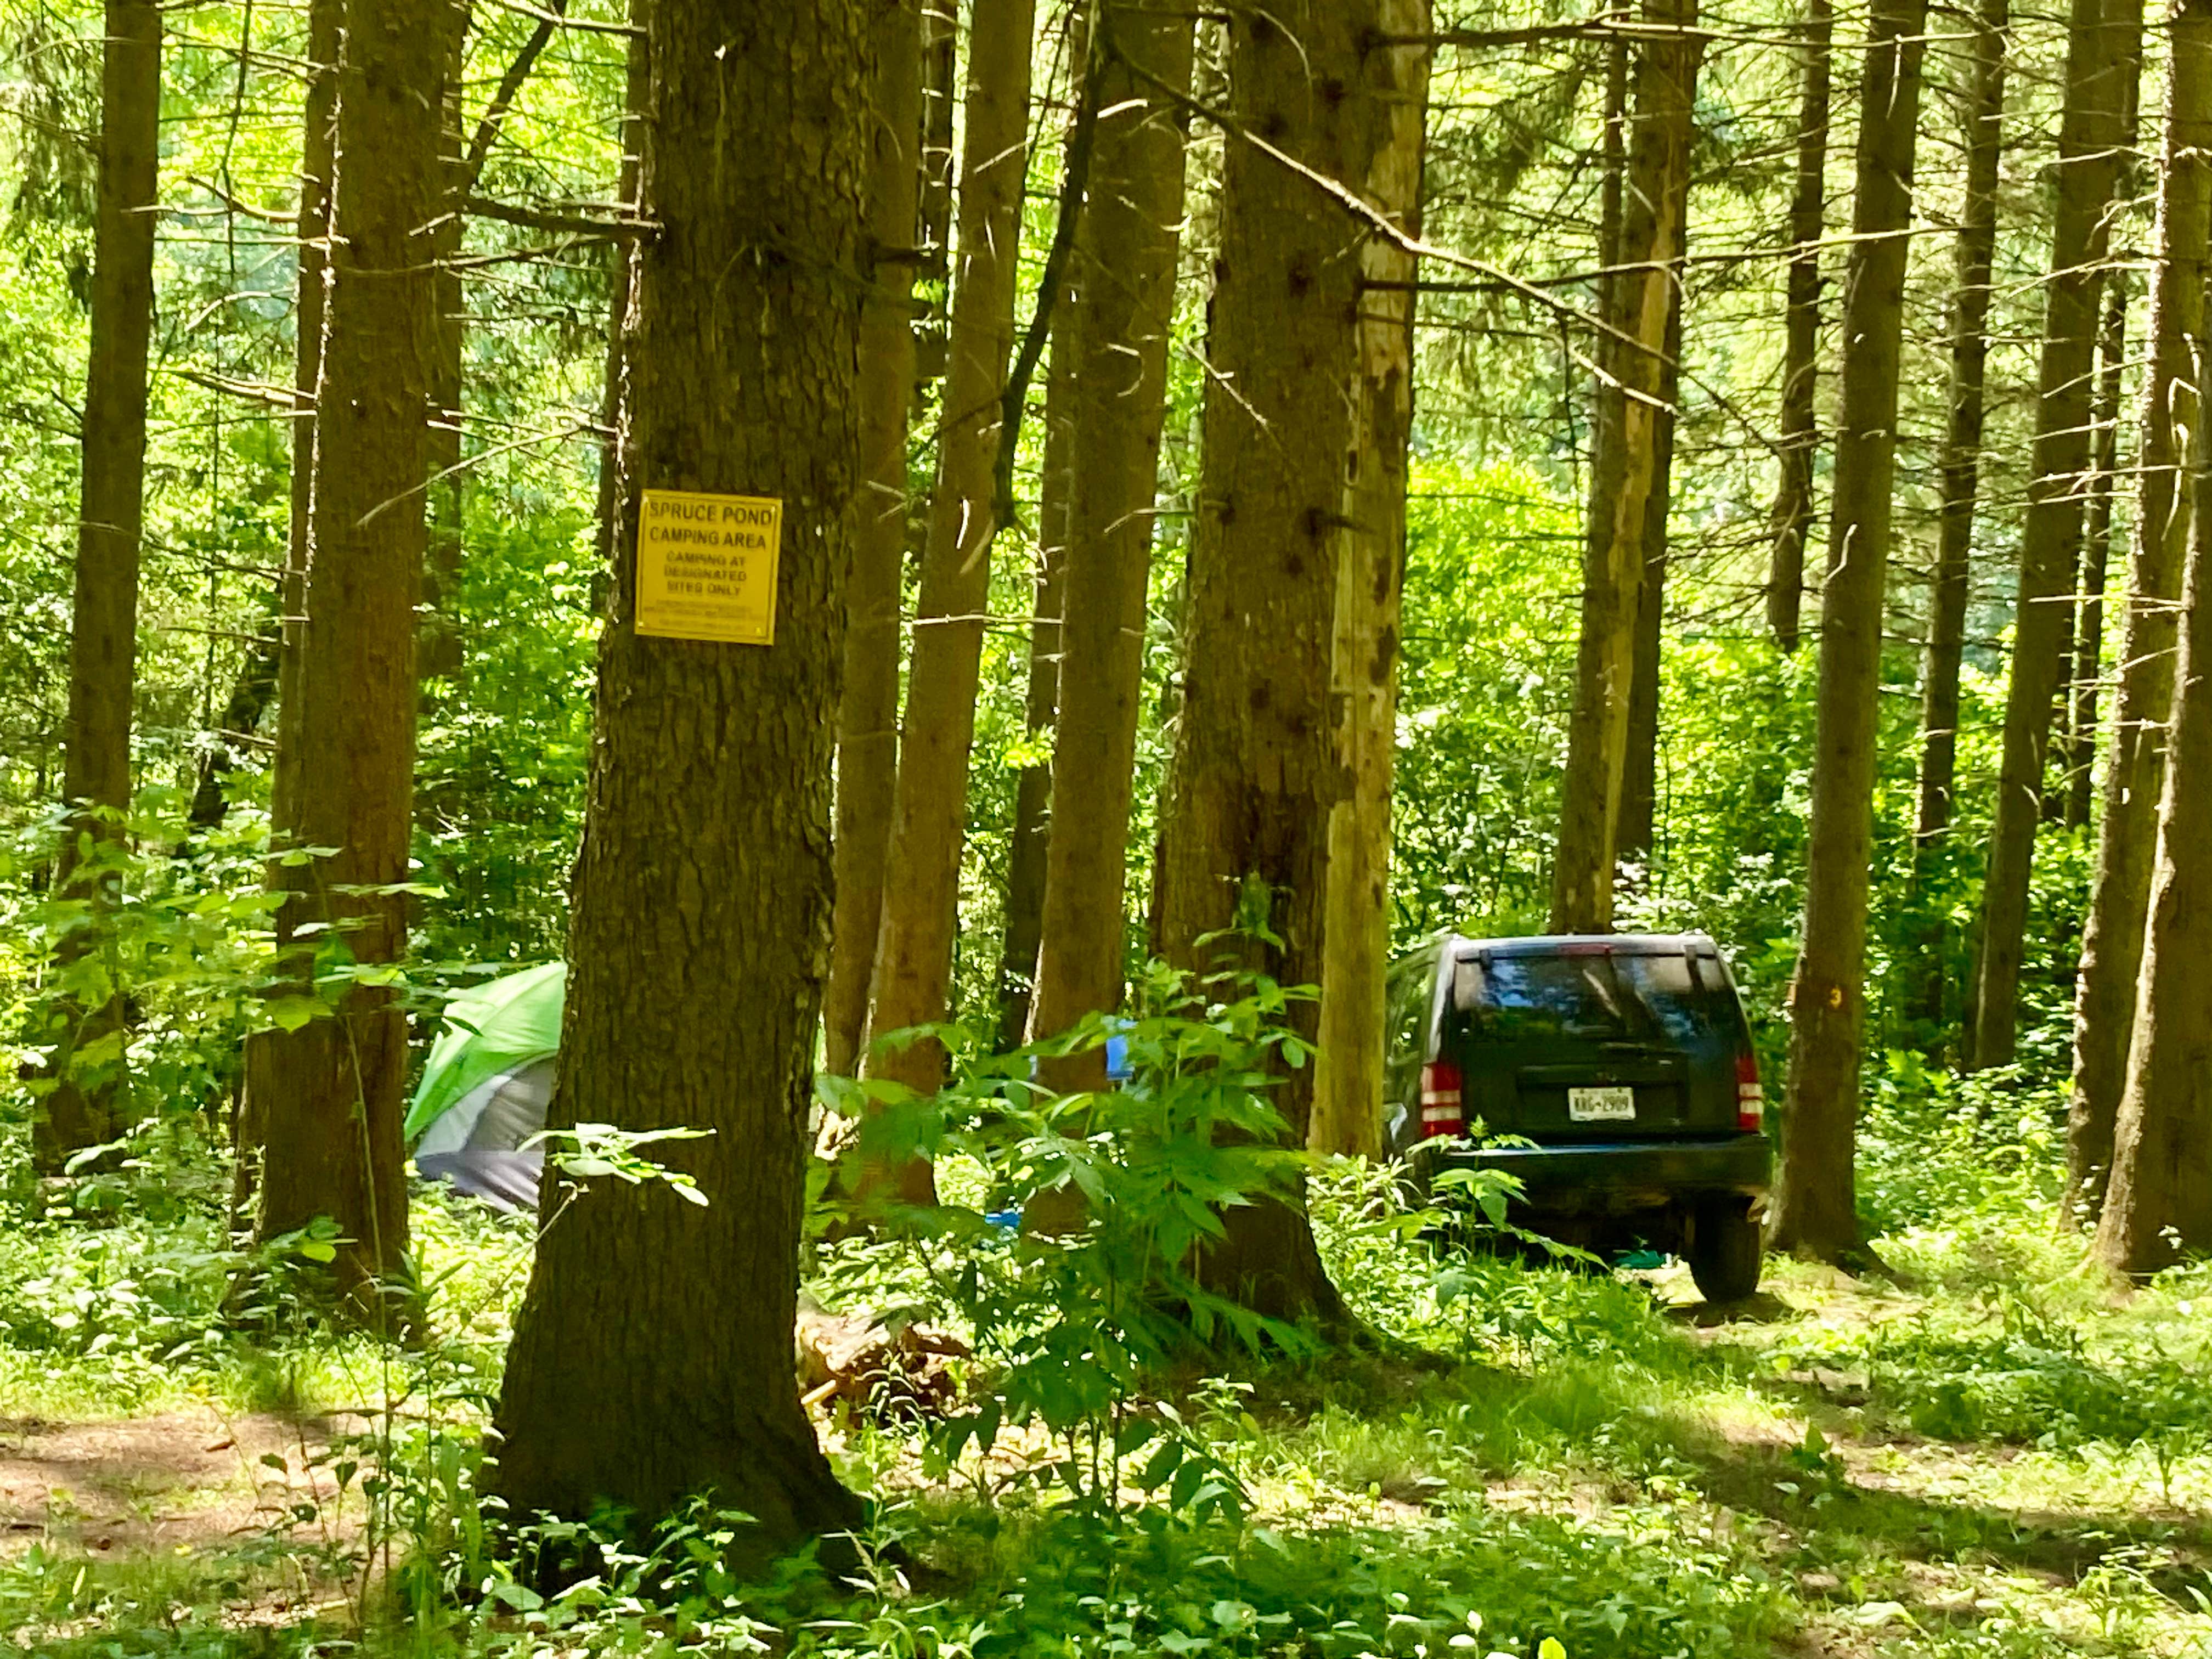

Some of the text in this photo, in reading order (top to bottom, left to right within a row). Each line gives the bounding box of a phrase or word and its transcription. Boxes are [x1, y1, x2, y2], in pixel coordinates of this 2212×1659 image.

[649, 501, 772, 526] SPRUCE POND
[650, 527, 766, 550] CAMPING AREA
[666, 550, 747, 567] CAMPING AT
[664, 566, 747, 582] DESIGNATED
[667, 581, 741, 596] SITES ONLY
